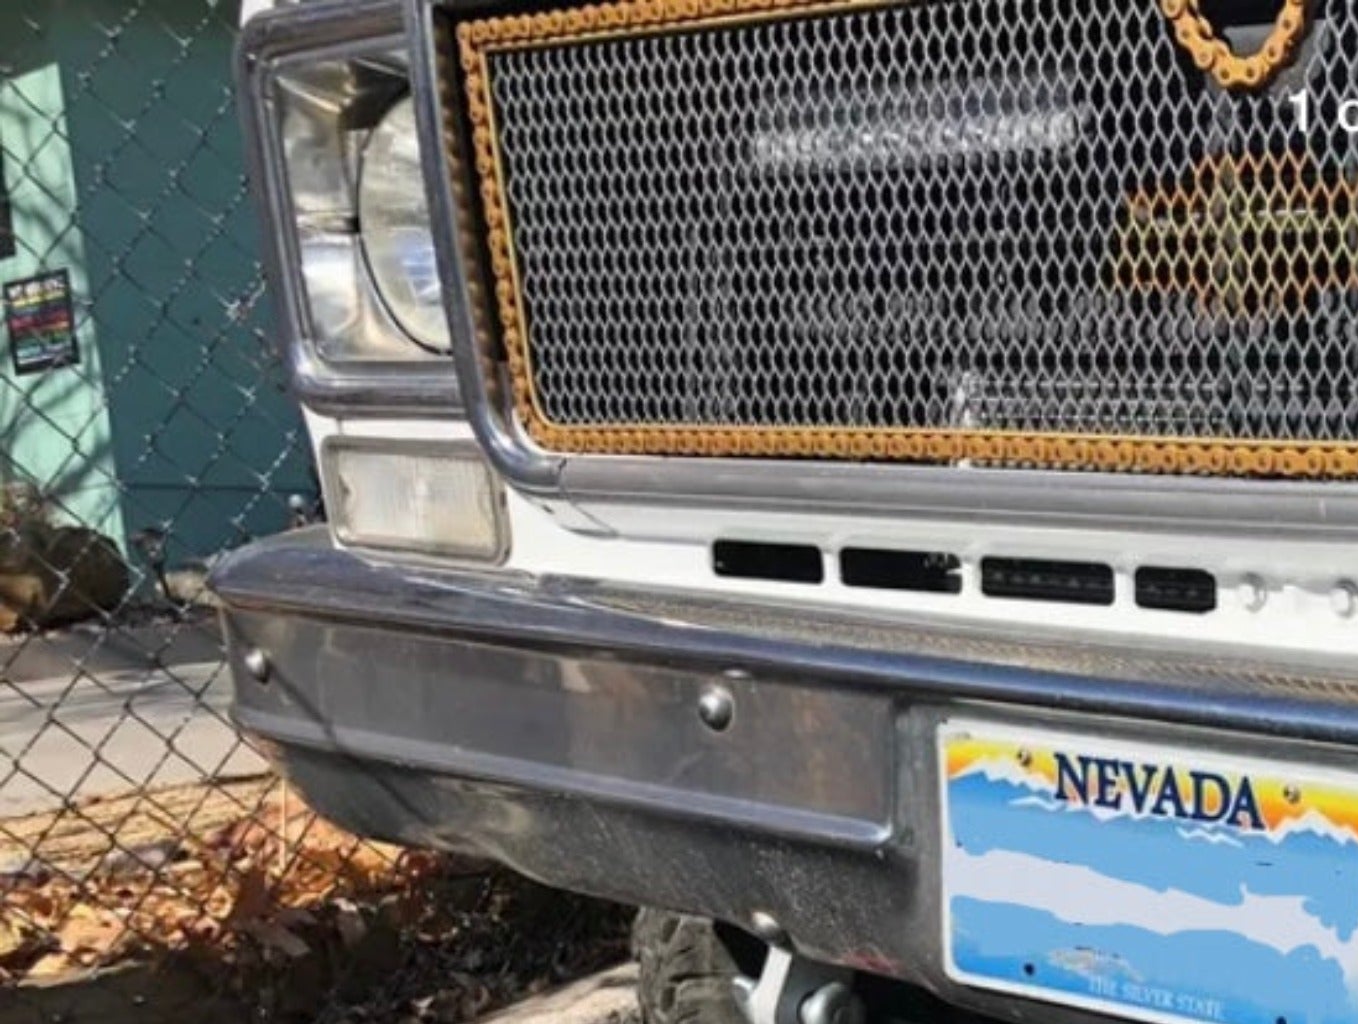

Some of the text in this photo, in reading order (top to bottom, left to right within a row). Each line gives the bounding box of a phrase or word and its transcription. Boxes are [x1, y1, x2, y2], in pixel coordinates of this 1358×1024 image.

[1054, 752, 1265, 829] NEVADA
[1089, 976, 1222, 1018] THE SILVER STATE
